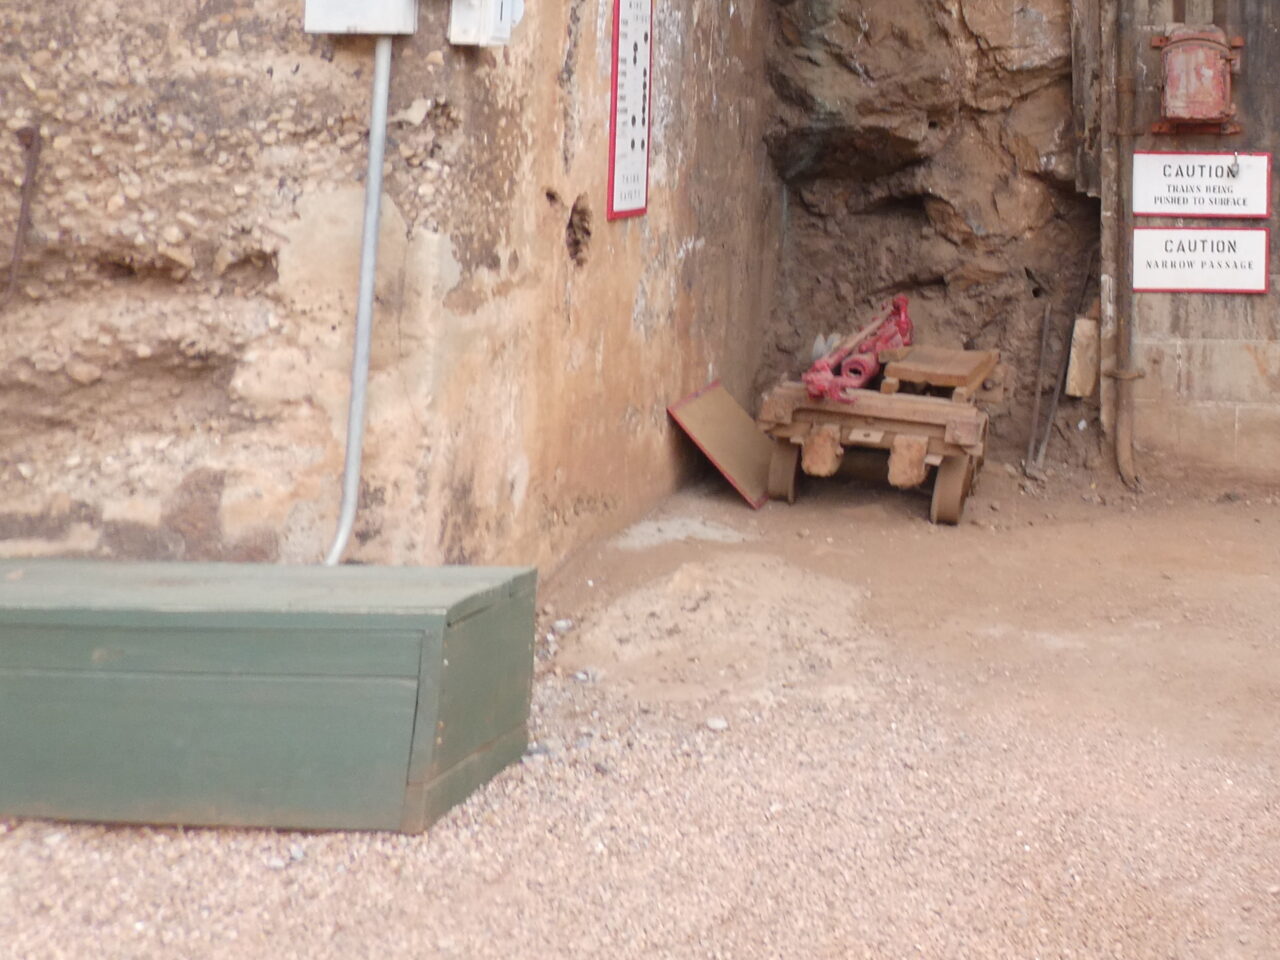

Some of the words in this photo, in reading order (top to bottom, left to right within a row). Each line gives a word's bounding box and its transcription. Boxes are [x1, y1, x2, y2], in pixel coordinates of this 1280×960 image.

[1162, 163, 1238, 179] CAUTION
[1166, 183, 1202, 194] TRAINS
[1205, 184, 1234, 194] BEING
[1153, 196, 1189, 206] PUSHED
[1193, 196, 1205, 206] TO
[1209, 197, 1248, 207] SURFACE
[1164, 239, 1237, 254] CAUTION
[1145, 259, 1195, 270] NARROW
[1200, 260, 1254, 271] PASSAGE
